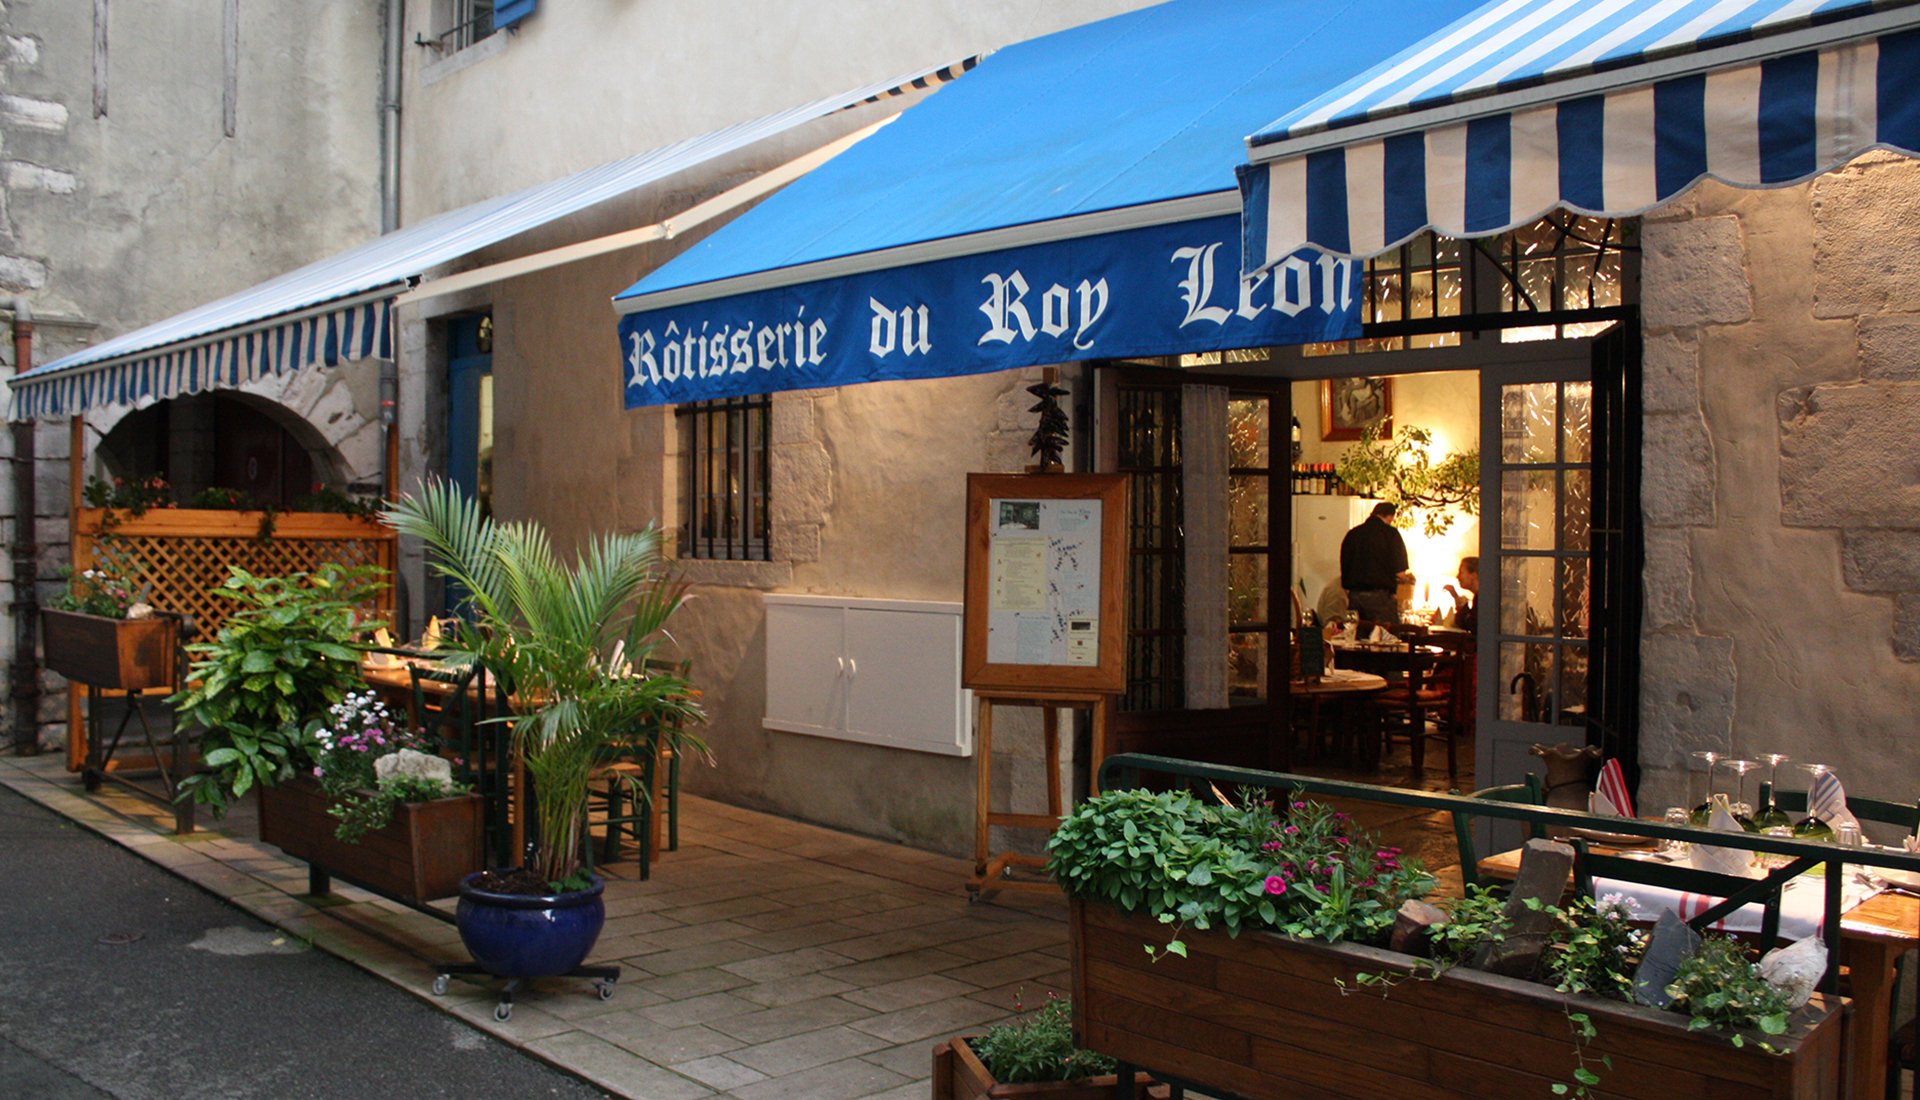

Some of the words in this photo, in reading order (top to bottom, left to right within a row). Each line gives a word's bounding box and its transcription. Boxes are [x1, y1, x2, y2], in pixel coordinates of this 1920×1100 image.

[628, 305, 827, 388] Rôtisserie
[869, 295, 932, 358] du
[977, 269, 1110, 351] Roy
